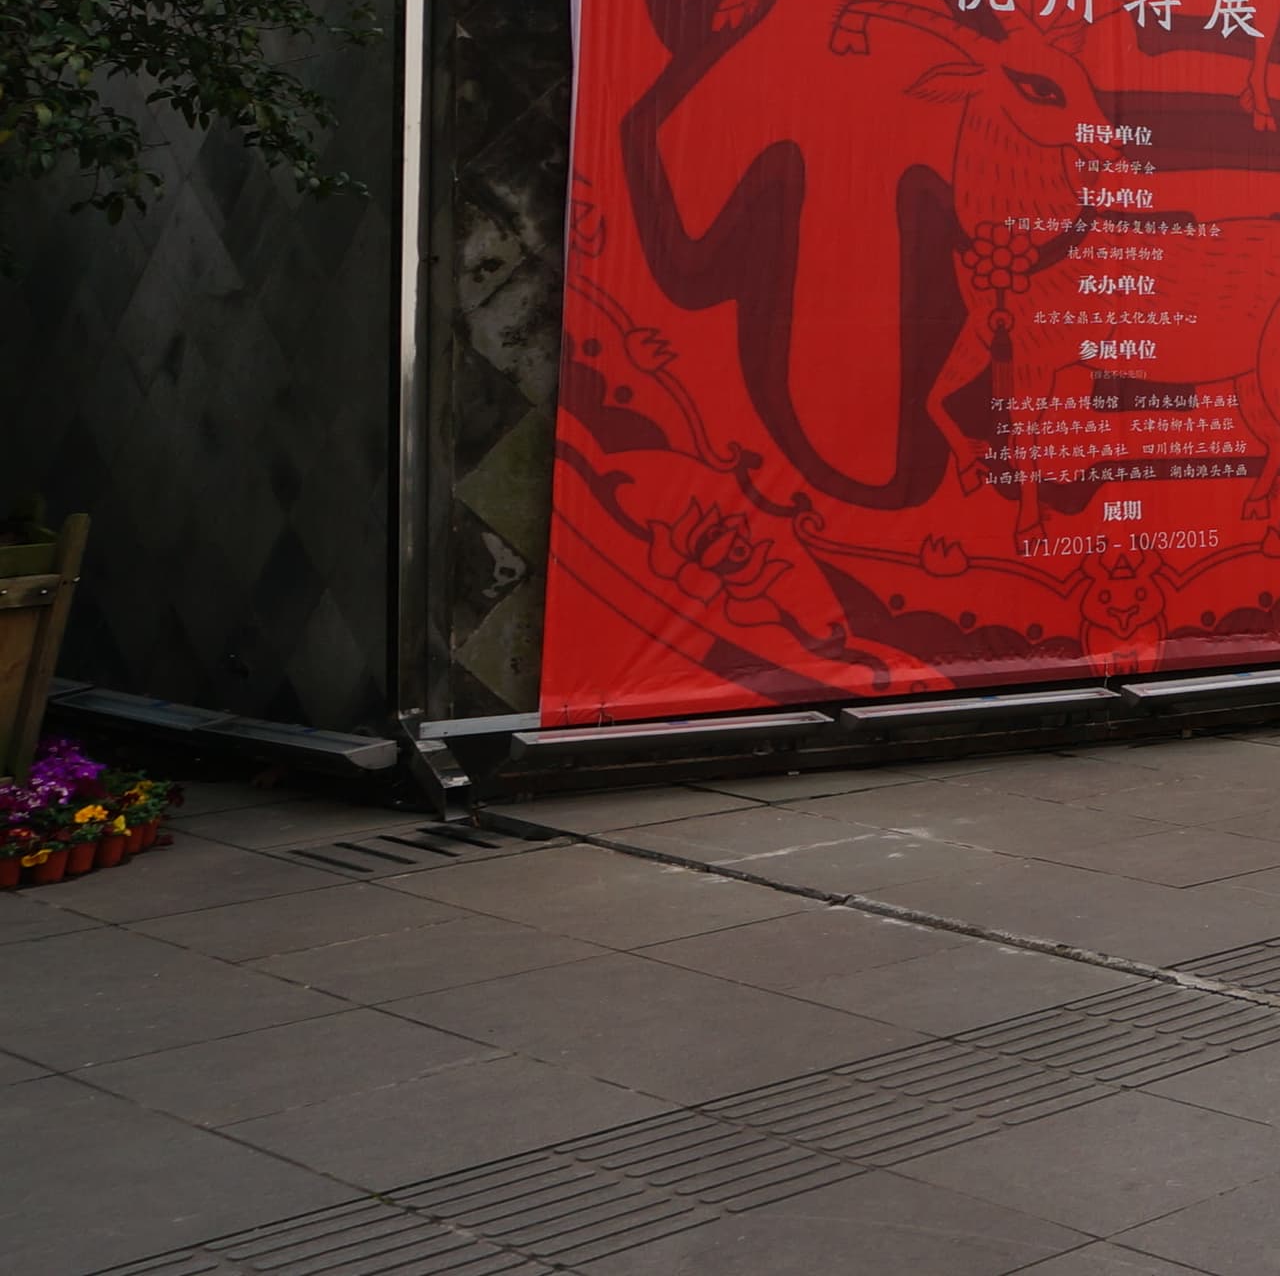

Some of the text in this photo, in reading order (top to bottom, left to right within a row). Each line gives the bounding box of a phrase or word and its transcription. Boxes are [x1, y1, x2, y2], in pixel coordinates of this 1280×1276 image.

[1076, 123, 1152, 146] 指导单位
[1075, 158, 1156, 175] 中国文物学会
[1077, 187, 1153, 208] 主办单位
[1067, 246, 1165, 261] 杭州西湖博物馆
[1078, 275, 1155, 295] 承办单位
[1079, 340, 1157, 360] 参展单位
[990, 395, 1120, 411] 河北武强年画博物馆
[1103, 500, 1142, 522] 展期
[1021, 535, 1106, 558] 1/1/2015
[1129, 529, 1219, 551] 10/3/2015
